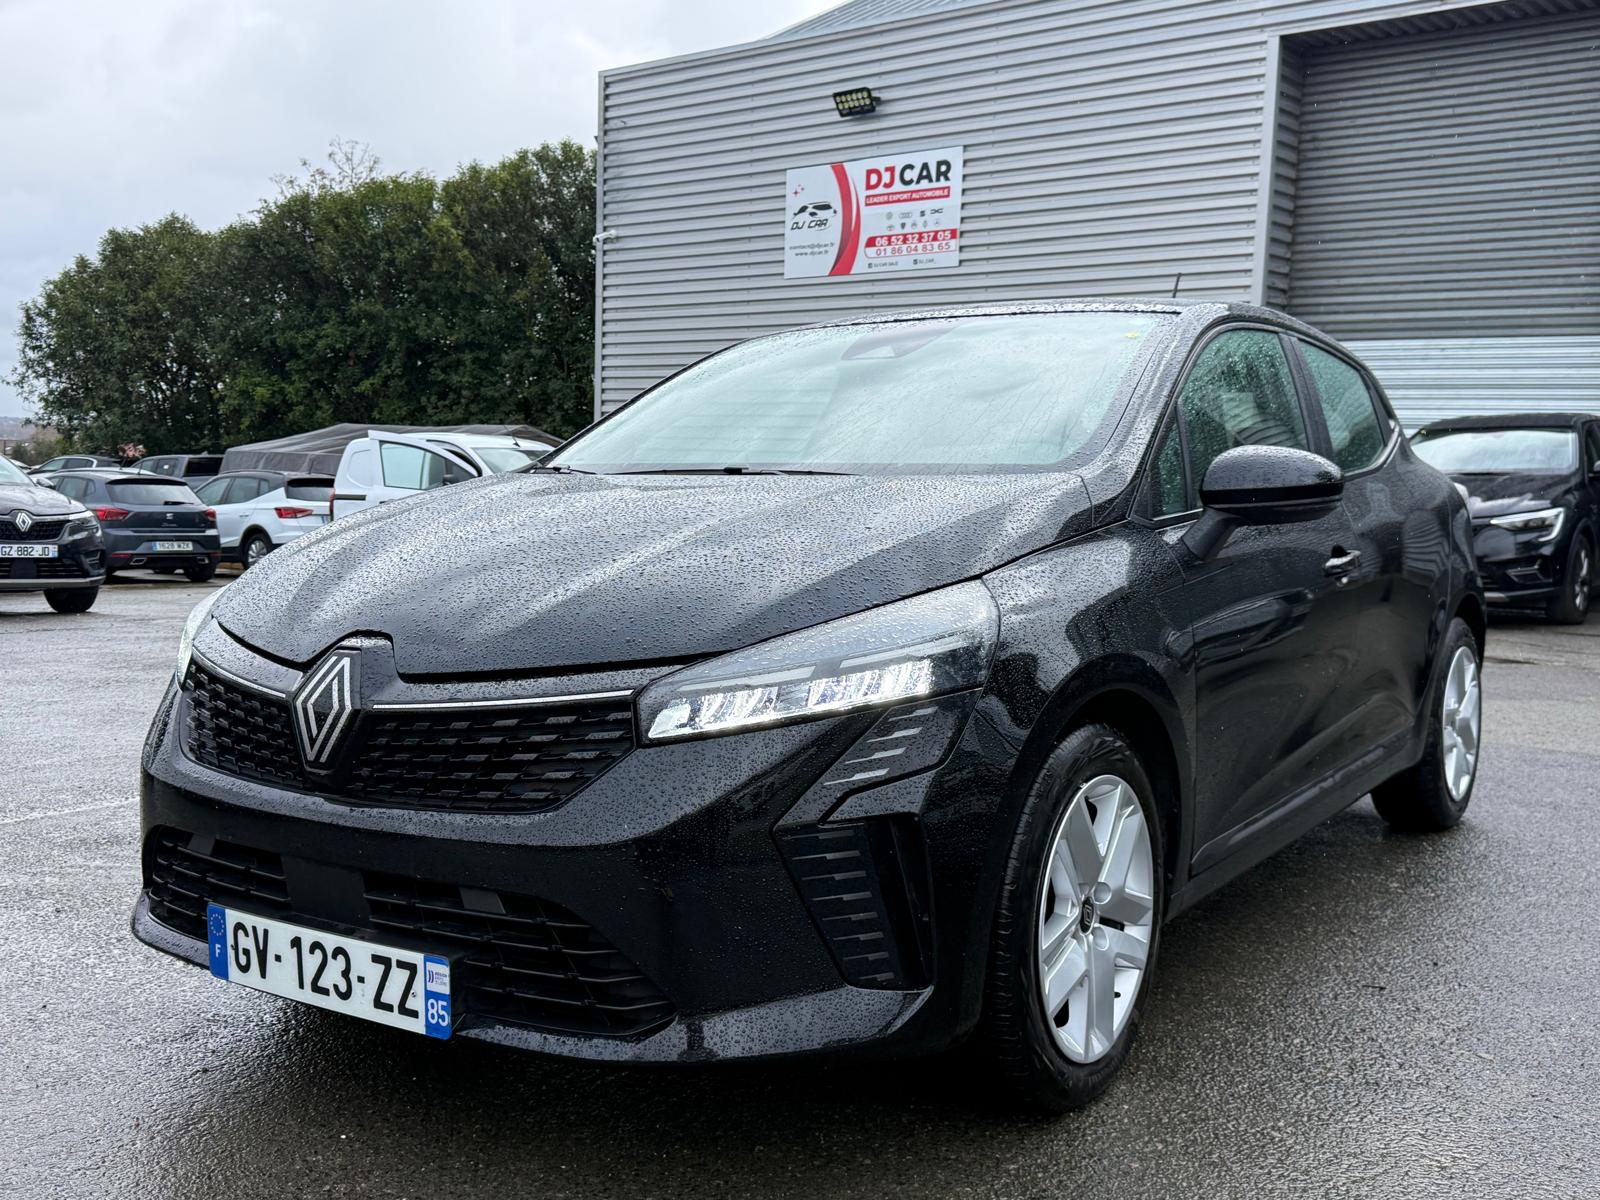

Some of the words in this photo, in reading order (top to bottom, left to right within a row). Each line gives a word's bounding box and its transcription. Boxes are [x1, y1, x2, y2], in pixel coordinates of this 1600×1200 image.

[866, 165, 896, 191] DJ
[899, 159, 952, 186] CAR
[866, 195, 889, 204] LEADER
[889, 192, 911, 201] EXPORT
[911, 188, 949, 199] AUTOMOBILE
[791, 221, 805, 230] DJ
[875, 236, 888, 246] 06
[891, 235, 905, 245] 52
[905, 233, 919, 244] 32
[921, 232, 935, 242] 37
[937, 231, 951, 240] 05
[876, 248, 887, 256] 01
[891, 246, 903, 255] 86
[906, 245, 918, 254] 04
[921, 243, 934, 252] 83
[938, 242, 951, 250] 65
[215, 944, 221, 958] F
[232, 921, 419, 1019] GV-123-ZZ
[427, 998, 448, 1027] 85
